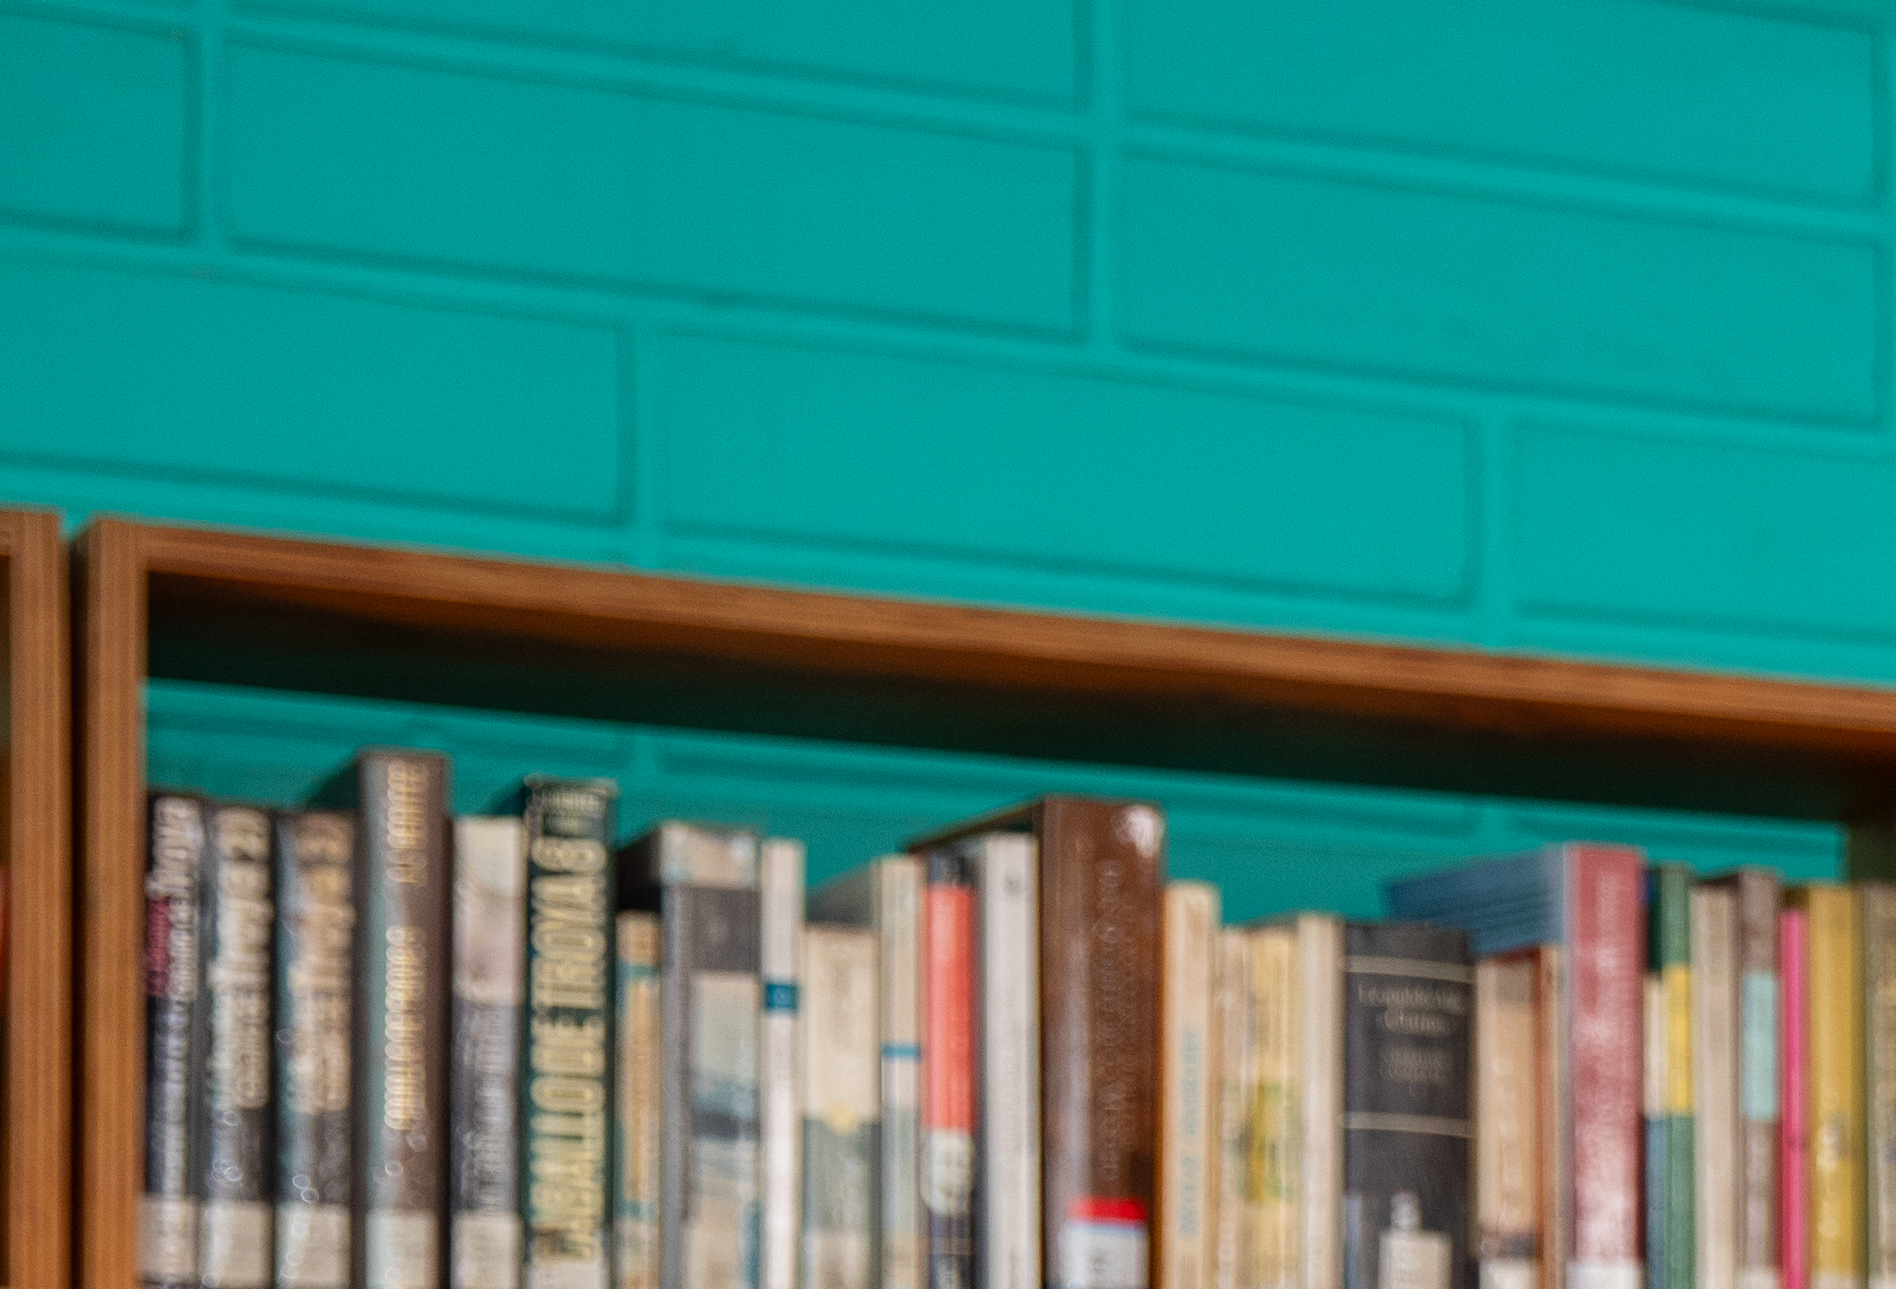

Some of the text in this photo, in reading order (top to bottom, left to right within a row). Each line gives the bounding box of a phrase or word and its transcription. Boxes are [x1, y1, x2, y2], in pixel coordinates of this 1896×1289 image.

[529, 877, 605, 1011] TROYA
[529, 1014, 605, 1073] DE
[529, 1076, 605, 1265] CABALLO
